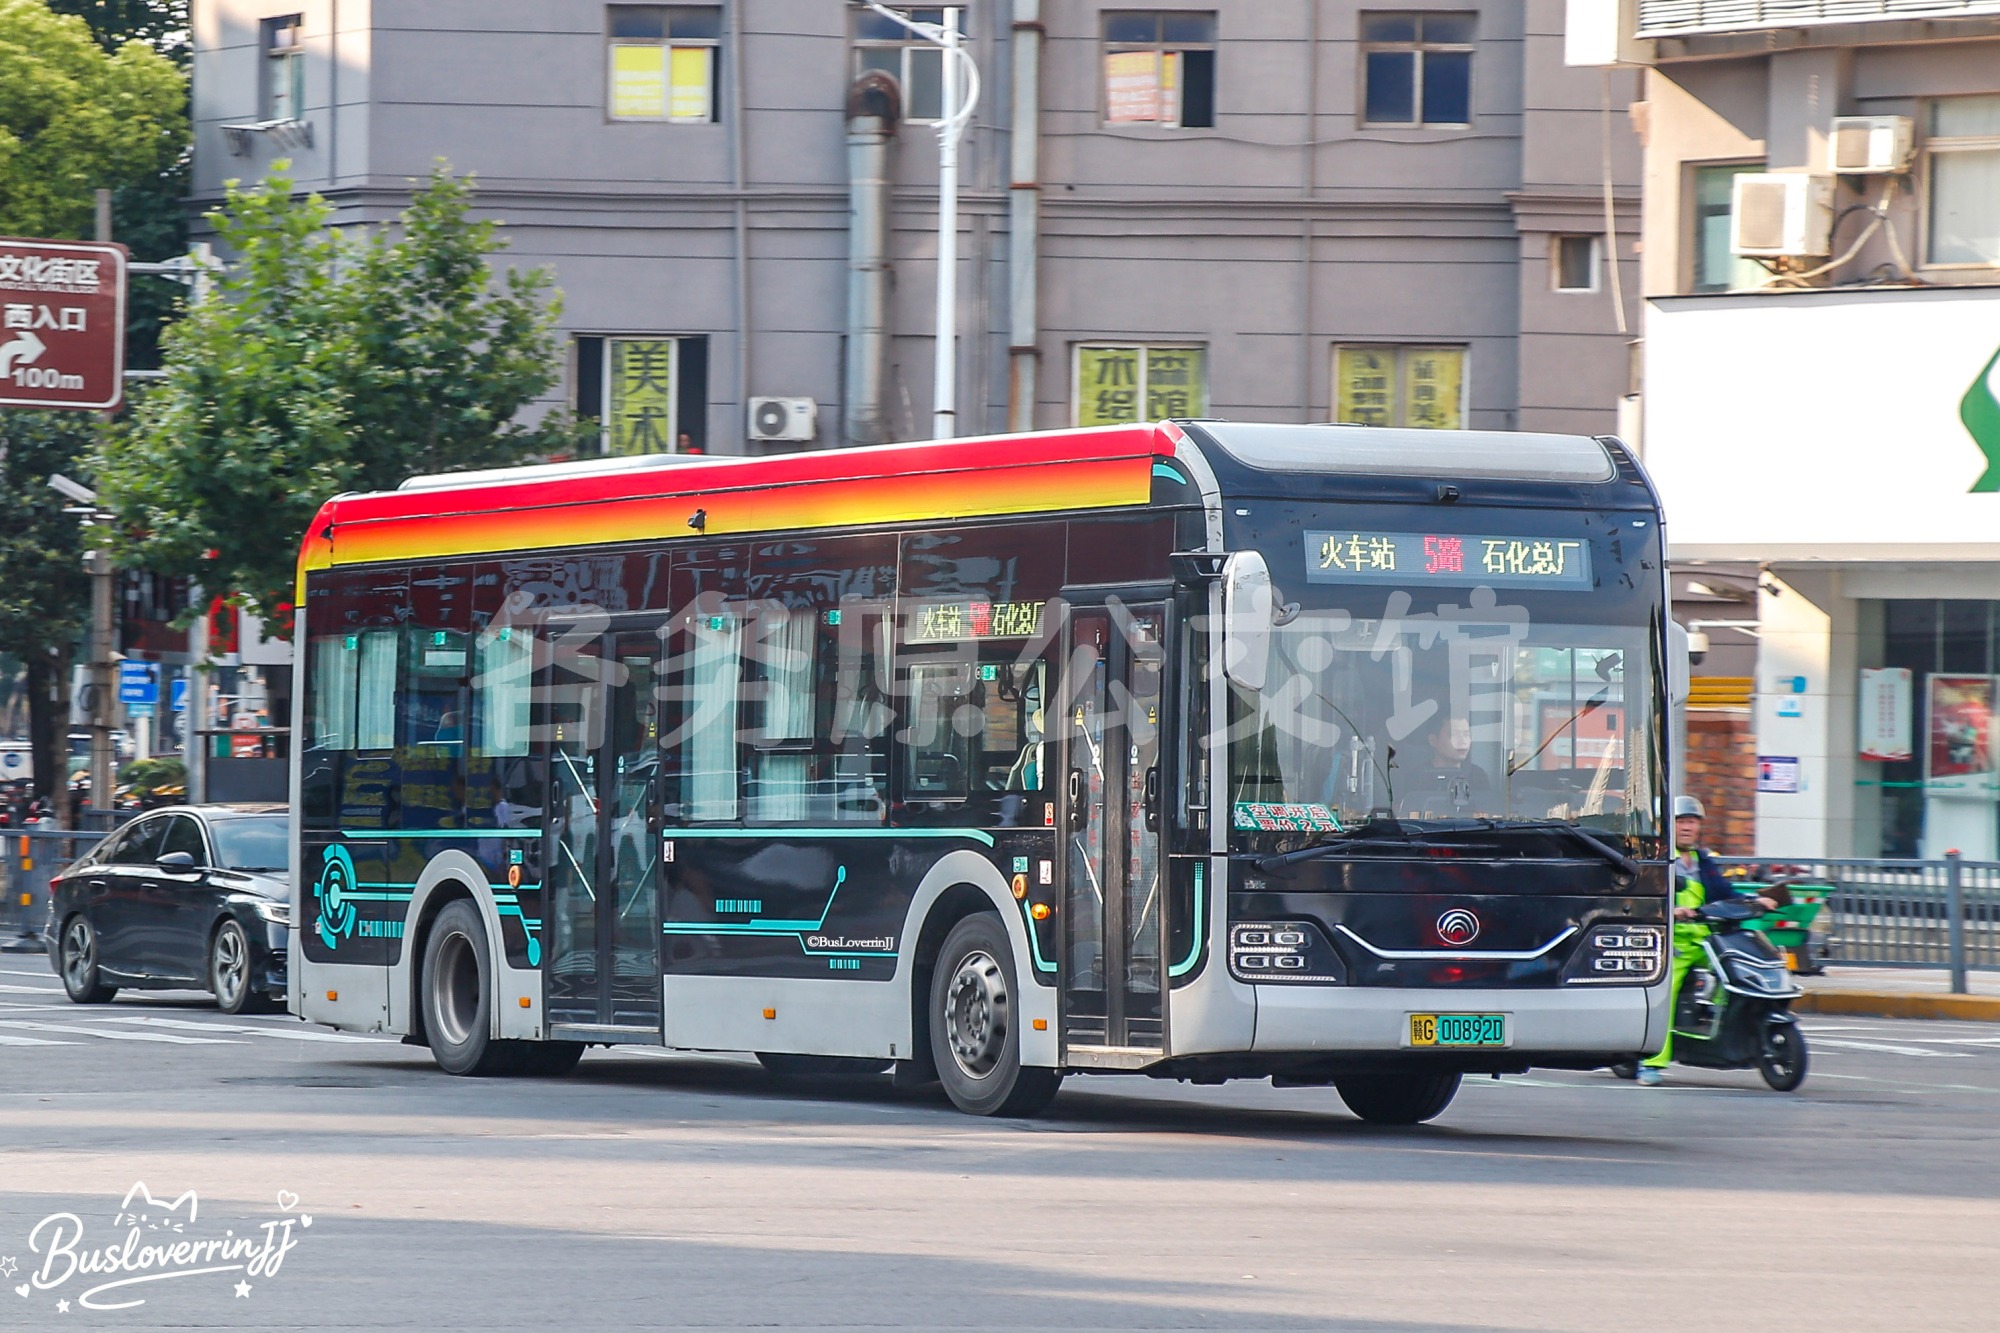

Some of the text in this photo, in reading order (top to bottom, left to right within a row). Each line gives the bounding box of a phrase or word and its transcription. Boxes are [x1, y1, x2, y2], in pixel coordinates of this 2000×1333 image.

[0, 255, 100, 285] 文化街区
[4, 303, 86, 332] 西入口
[11, 367, 84, 389] 100m
[624, 343, 668, 454] 美术
[1320, 534, 1580, 574] 火车站 5路 石化总厂
[922, 604, 962, 639] 火车站
[993, 602, 1045, 635] 石化总厂
[1247, 804, 1330, 819] 空调开启
[1257, 819, 1339, 831] 票价2元
